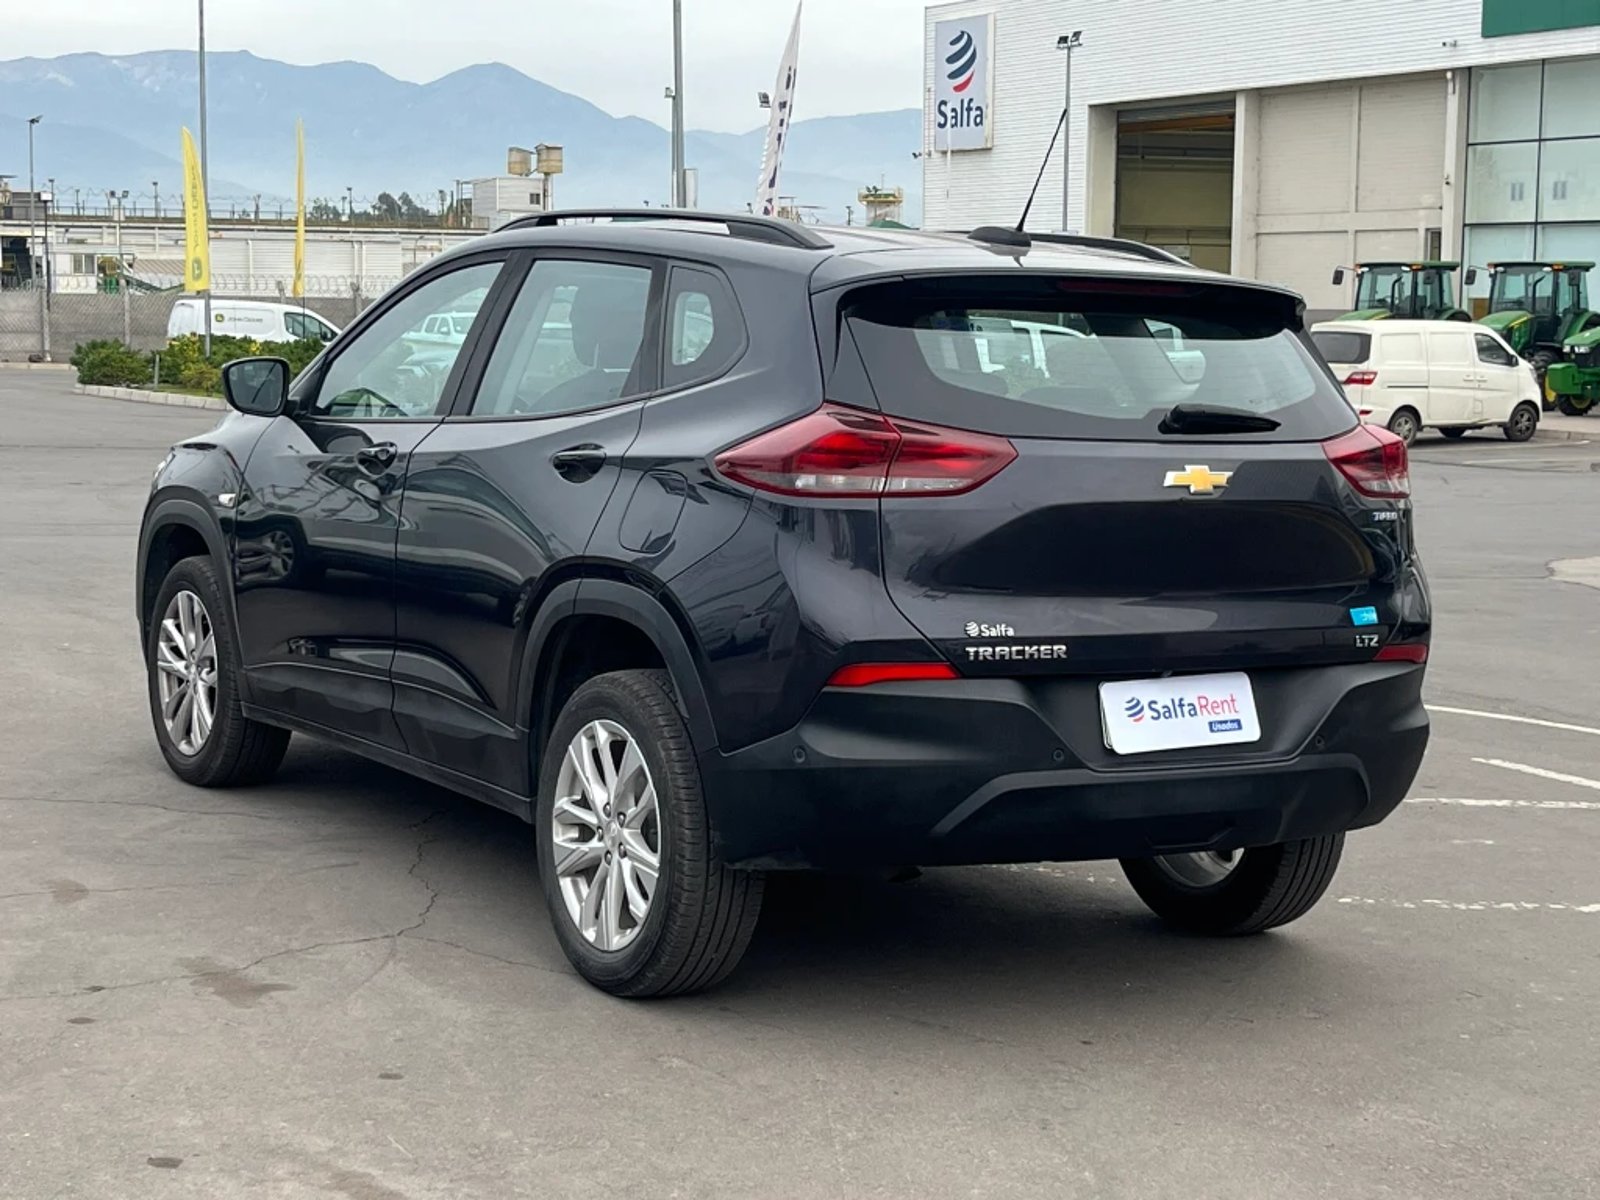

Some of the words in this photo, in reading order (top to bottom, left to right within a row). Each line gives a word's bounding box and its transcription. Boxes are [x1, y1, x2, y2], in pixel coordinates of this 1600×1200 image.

[938, 98, 983, 129] Salfa
[980, 623, 1014, 636] Salfa
[1355, 635, 1379, 647] LTZ
[965, 645, 1067, 661] TRACKER
[1147, 693, 1239, 721] SalfaRent
